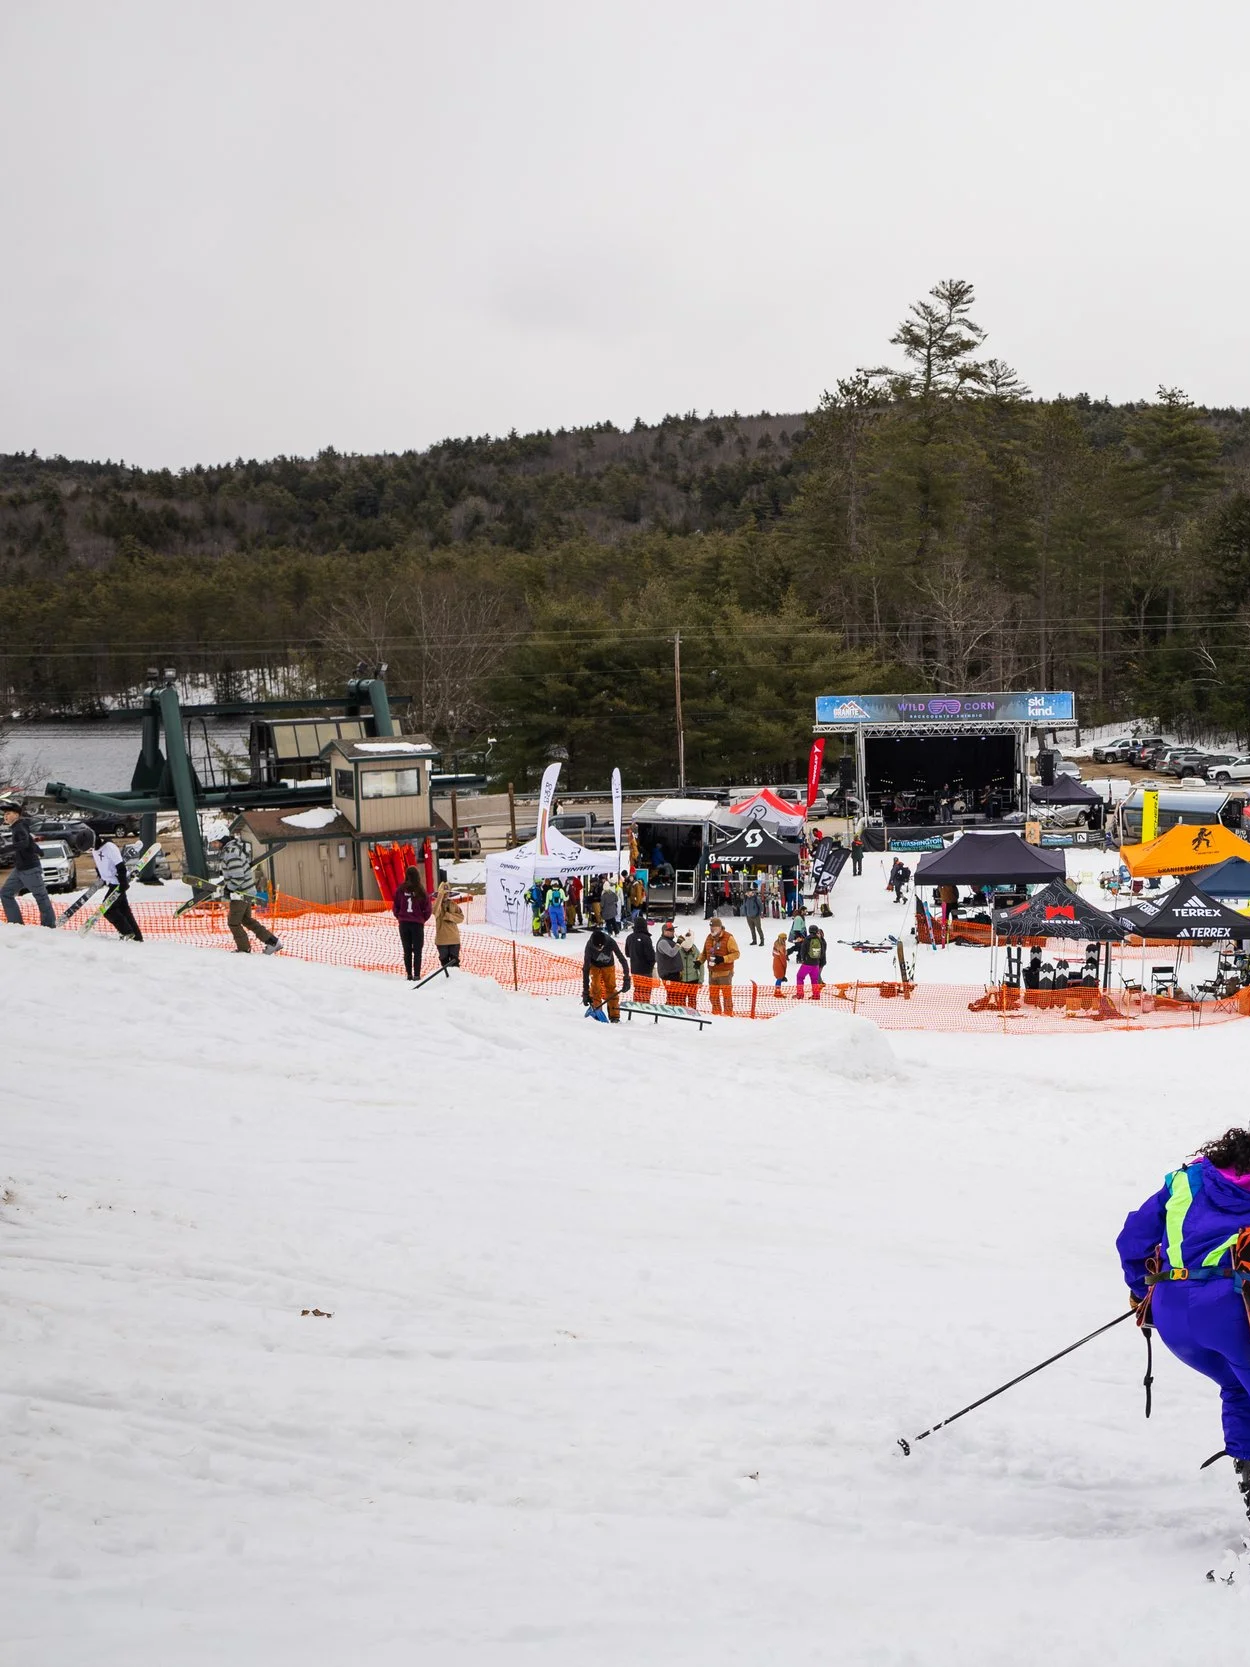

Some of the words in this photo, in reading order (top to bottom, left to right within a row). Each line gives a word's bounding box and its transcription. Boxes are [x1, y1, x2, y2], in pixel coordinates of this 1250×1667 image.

[1028, 696, 1045, 706] ski
[898, 703, 925, 711] WILD
[964, 702, 995, 711] CORN
[1028, 706, 1055, 716] kind.
[900, 838, 942, 848] WASHINGTON
[560, 865, 595, 873] DYNAFIT
[406, 897, 413, 913] 1
[1172, 908, 1222, 917] TERREX
[1190, 927, 1231, 938] TERREX
